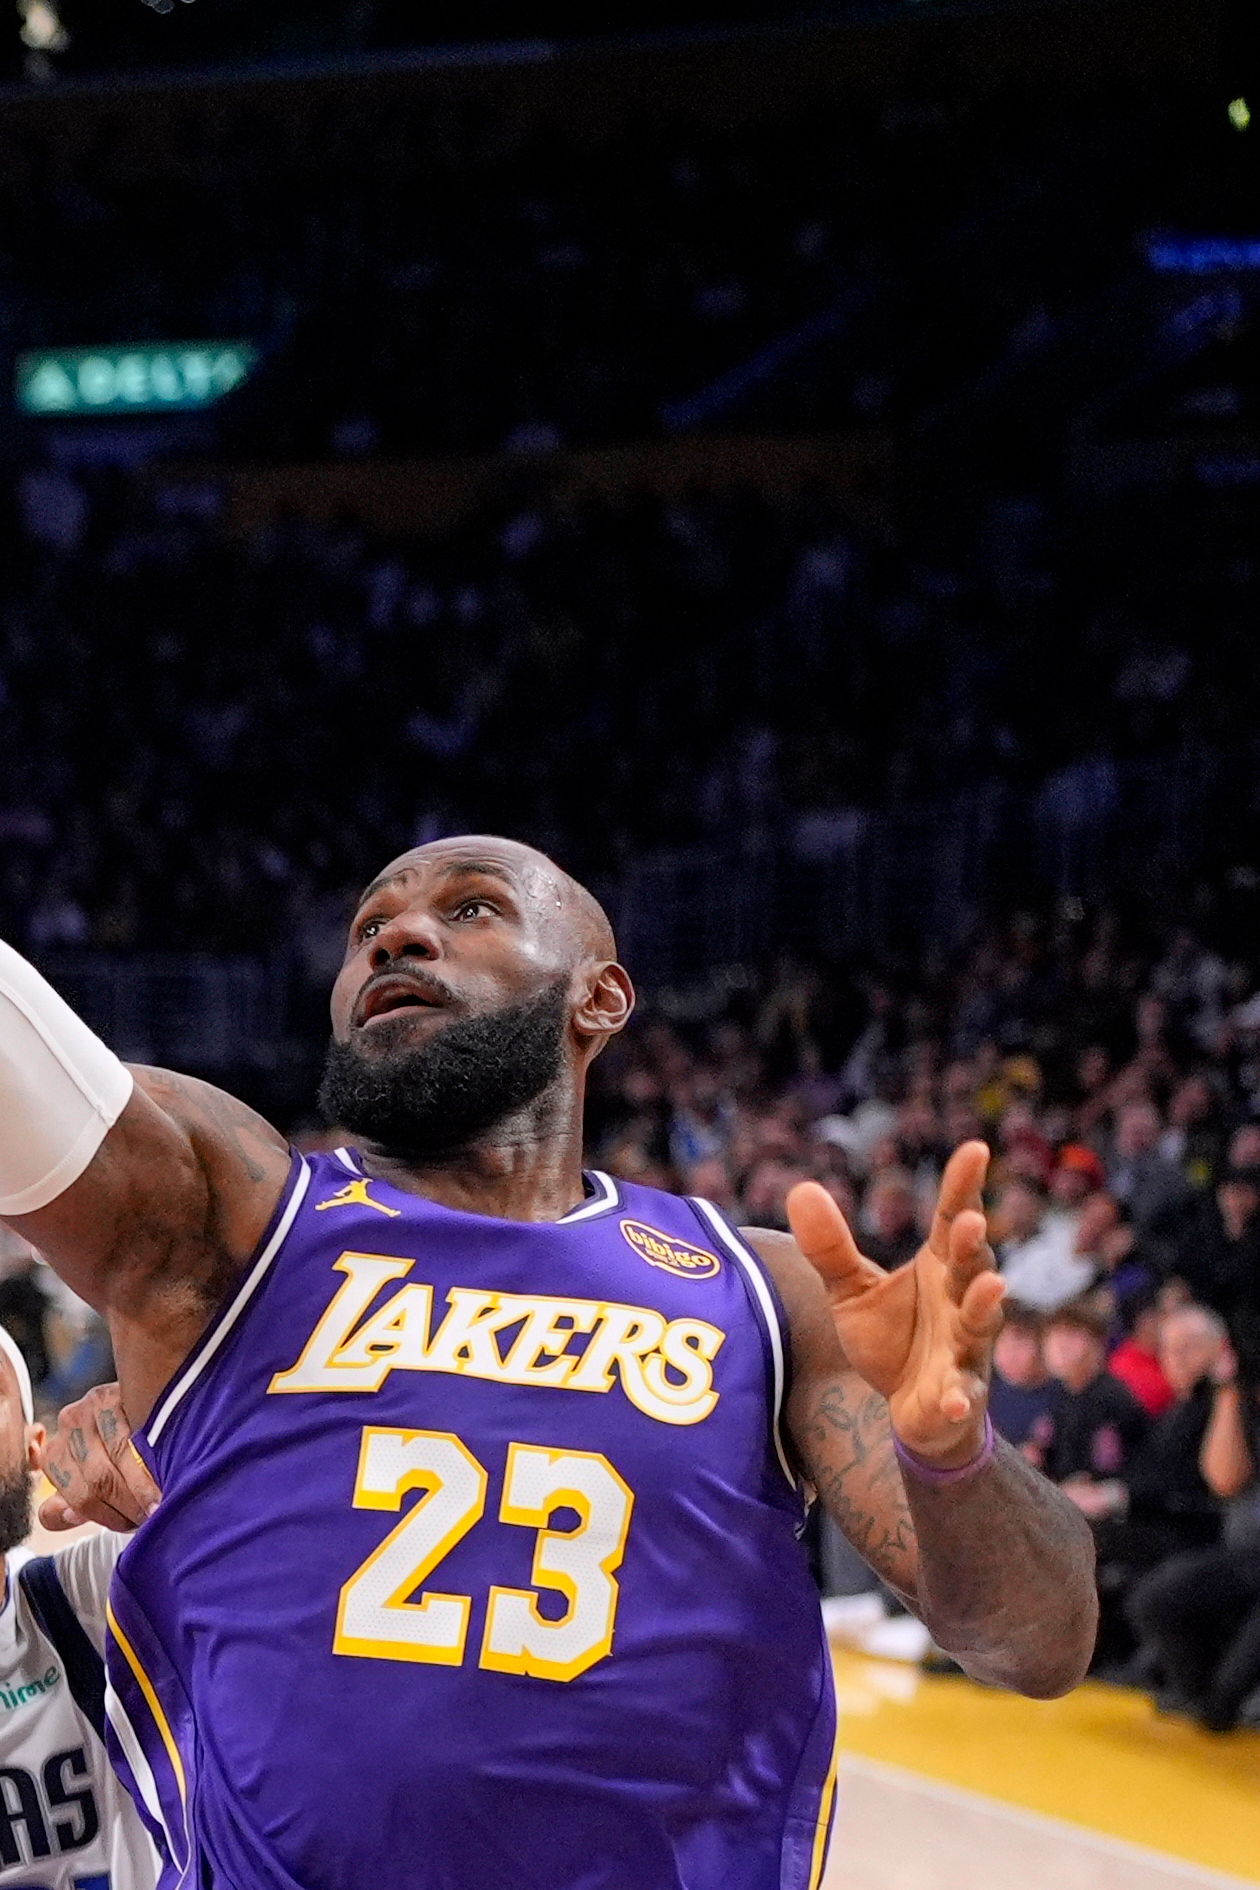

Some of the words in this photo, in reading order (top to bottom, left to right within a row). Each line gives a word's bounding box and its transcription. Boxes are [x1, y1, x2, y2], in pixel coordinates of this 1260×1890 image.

[626, 1226, 712, 1269] bibigo
[266, 1250, 726, 1426] LAKERS
[332, 1425, 635, 1683] 23
